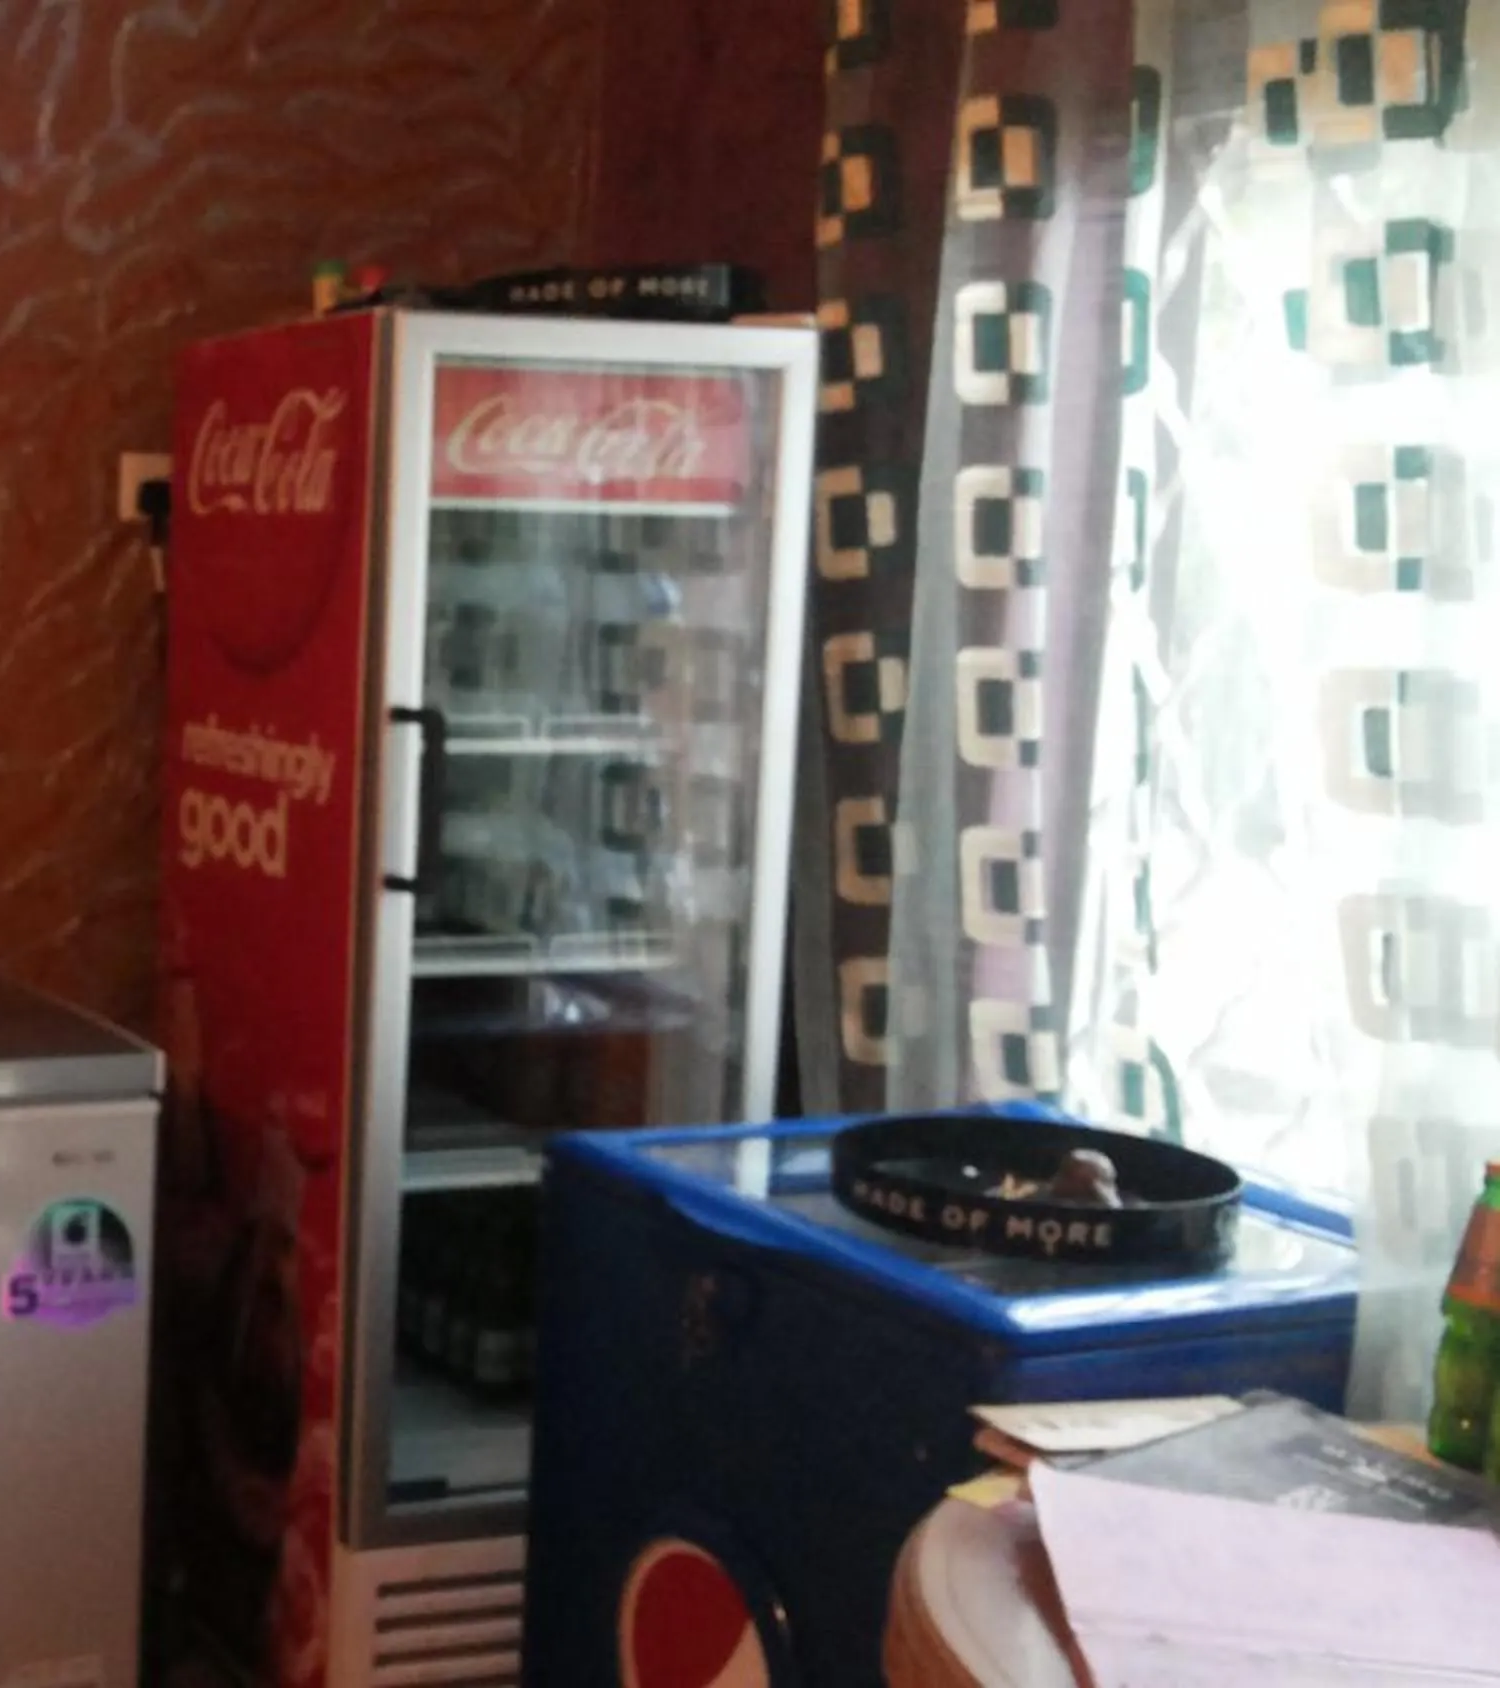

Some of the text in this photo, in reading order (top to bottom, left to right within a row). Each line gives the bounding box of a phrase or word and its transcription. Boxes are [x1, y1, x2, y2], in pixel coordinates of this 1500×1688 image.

[587, 277, 625, 299] OF
[636, 275, 709, 298] MORE
[178, 787, 290, 880] good
[852, 1178, 1113, 1254] MADE OF MORE
[8, 1272, 39, 1317] 5
